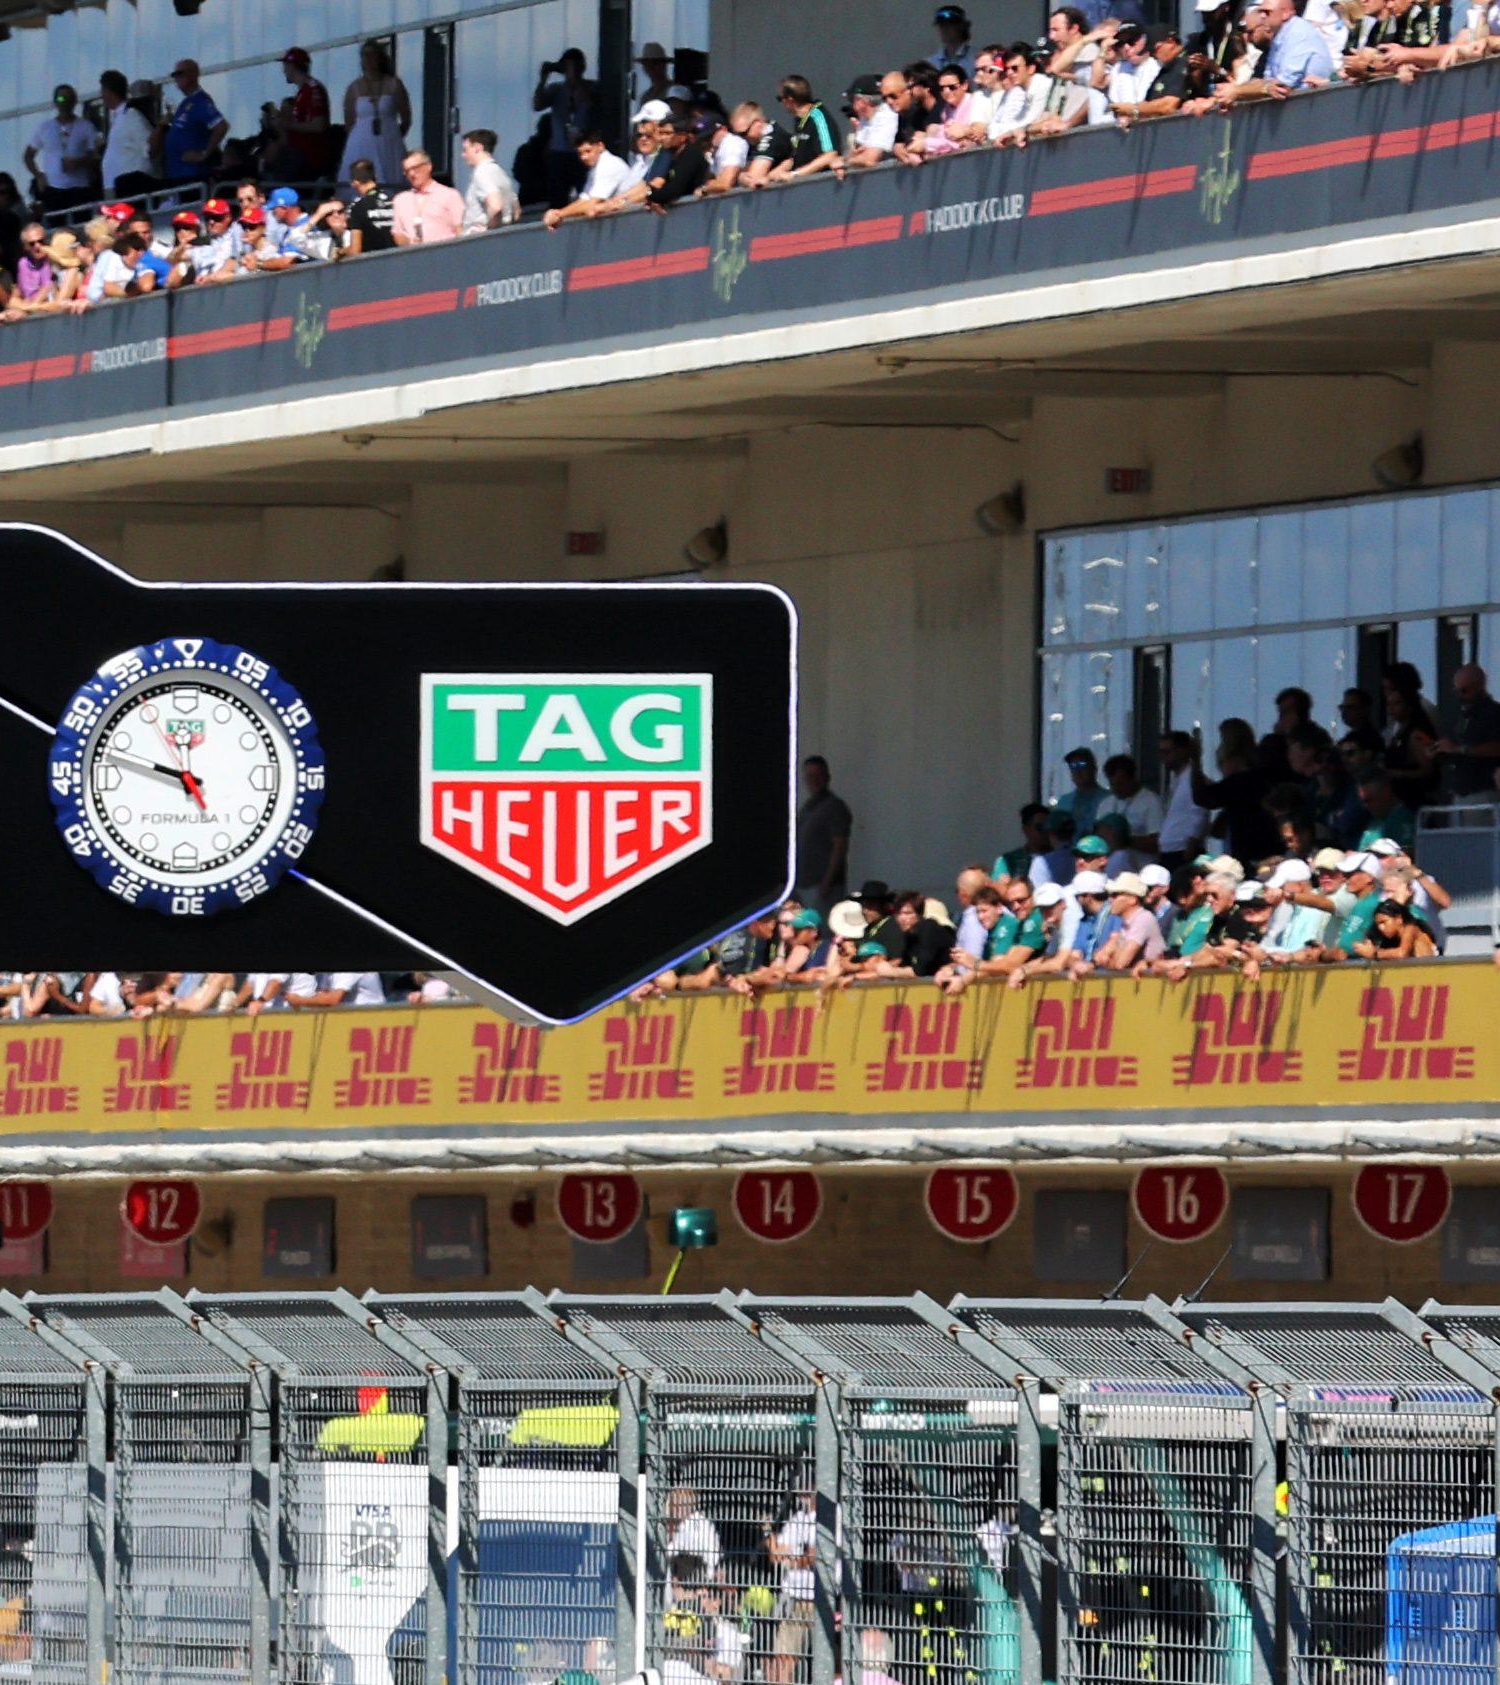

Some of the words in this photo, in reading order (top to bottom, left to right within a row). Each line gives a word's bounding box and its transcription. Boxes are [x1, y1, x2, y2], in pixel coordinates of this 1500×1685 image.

[446, 692, 683, 764] TAG
[442, 789, 694, 898] HEUER
[2, 1186, 29, 1229] 11
[146, 1184, 180, 1231] 12
[583, 1184, 616, 1227] 13
[760, 1180, 797, 1225] 14
[954, 1176, 993, 1224] 15
[1161, 1174, 1199, 1223] 16
[1383, 1174, 1427, 1223] 17
